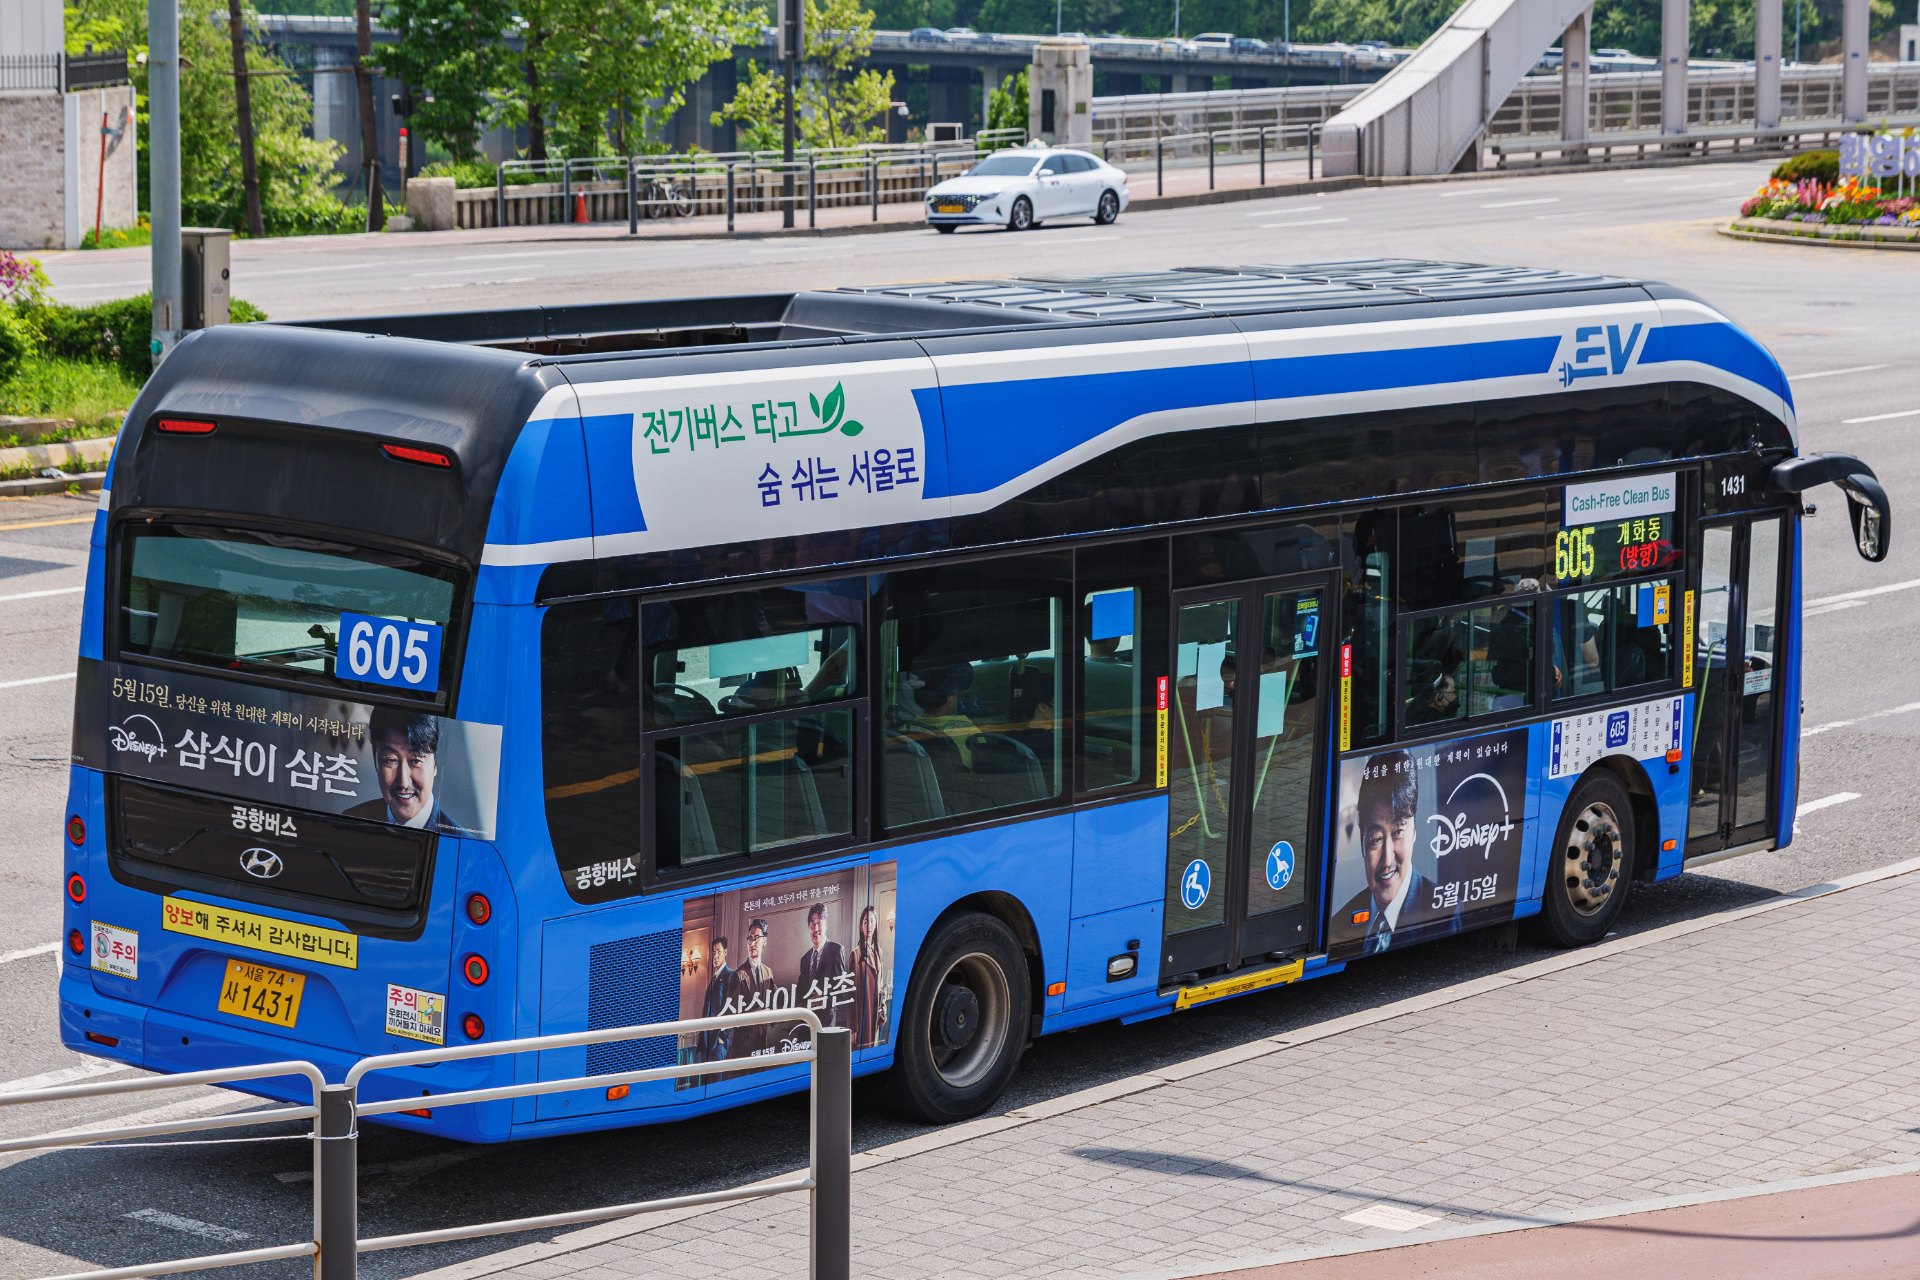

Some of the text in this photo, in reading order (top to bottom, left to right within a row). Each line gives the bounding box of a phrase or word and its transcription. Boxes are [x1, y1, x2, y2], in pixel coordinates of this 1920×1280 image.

[1574, 323, 1643, 375] EV
[642, 400, 799, 455] 전기버스 타고
[757, 447, 920, 507] 숨 쉬는 서울로
[1721, 475, 1745, 496] 1431
[1571, 486, 1670, 512] Cash-Free Clean Bus
[1616, 517, 1661, 545] 개화동
[1556, 527, 1595, 580] 605
[349, 621, 429, 684] 605
[176, 694, 207, 714] 당신을
[210, 700, 232, 718] 위한
[235, 704, 267, 724] 원대한
[270, 711, 303, 731] 계획이
[306, 716, 364, 741] 시작됩니다
[1610, 720, 1626, 738] 605
[174, 728, 361, 797] 삼식이 삼촌
[1363, 741, 1508, 780] 당신을 위한 원대한 계획이 있습니다
[231, 805, 298, 837] 공항버스
[1427, 813, 1514, 860] Disney+
[576, 857, 637, 890] 공항버스
[743, 899, 760, 911] 혼돈의
[777, 892, 795, 905] 모두가
[796, 890, 808, 901] 다른
[809, 888, 821, 899] 꿈을
[822, 884, 840, 896] 꾸었다
[165, 904, 354, 960] 양보해 주셔서 감사합니다.
[112, 941, 136, 964] 주의
[244, 965, 284, 987] 서울 74
[803, 971, 857, 1011] 삼촌
[389, 988, 417, 1010] 주의
[389, 1008, 416, 1021] 우회전시
[388, 1018, 441, 1036] 끼어들지 마세요
